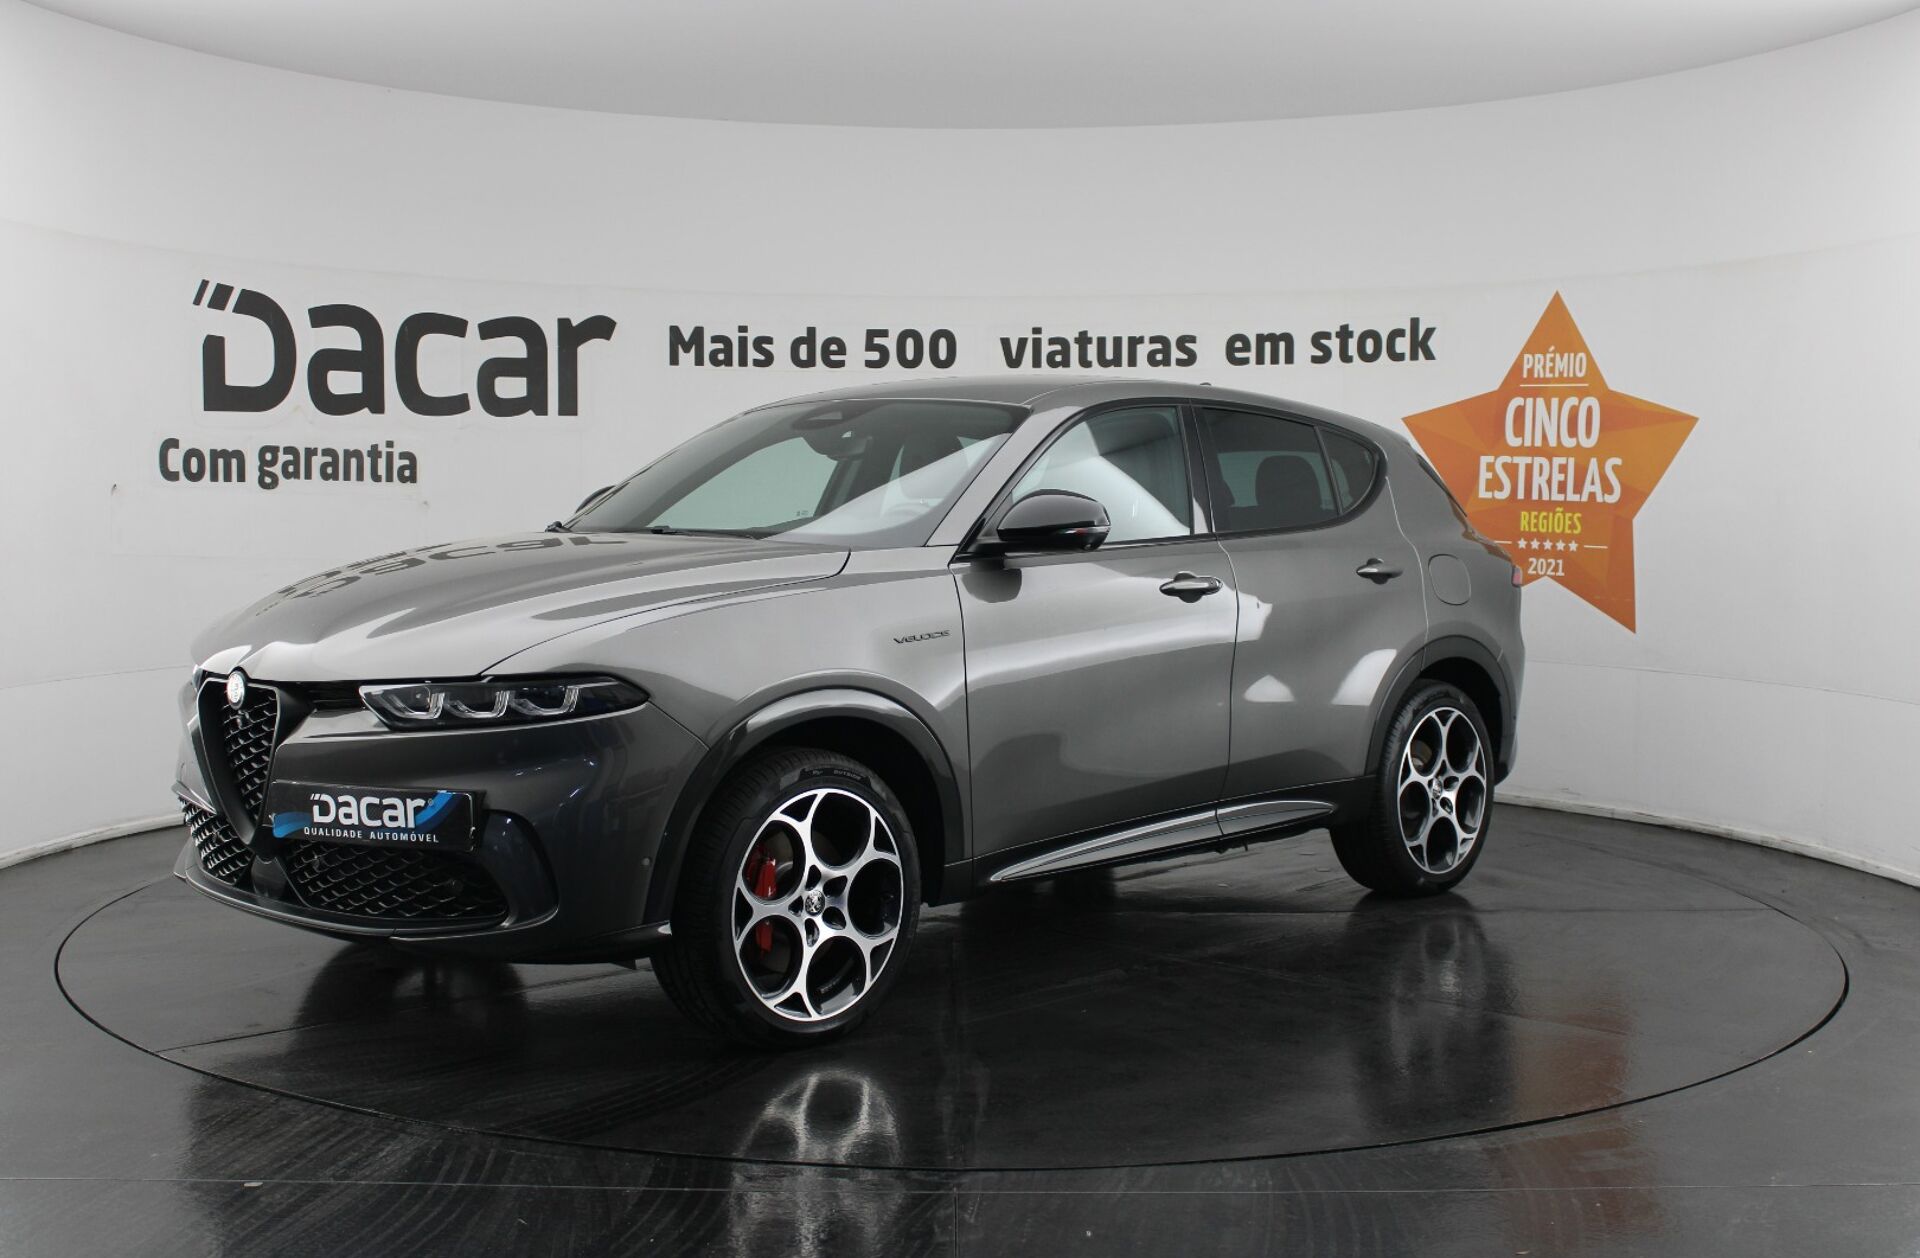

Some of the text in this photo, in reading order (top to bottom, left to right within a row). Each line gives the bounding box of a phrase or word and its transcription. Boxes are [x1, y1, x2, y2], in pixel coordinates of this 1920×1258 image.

[192, 279, 617, 417] Dacar
[669, 318, 1437, 369] Mais de 500 viaturas em stock
[1522, 346, 1587, 378] PRÉMIO
[1505, 397, 1600, 448] CINCO
[159, 438, 418, 489] Com garantia
[1478, 456, 1622, 504] ESTRELAS
[1520, 507, 1582, 534] REGIÕES
[1527, 557, 1565, 577] 2021
[310, 793, 426, 828] Dacar
[303, 826, 439, 843] QUALIDADE AUTOMÓVEL
